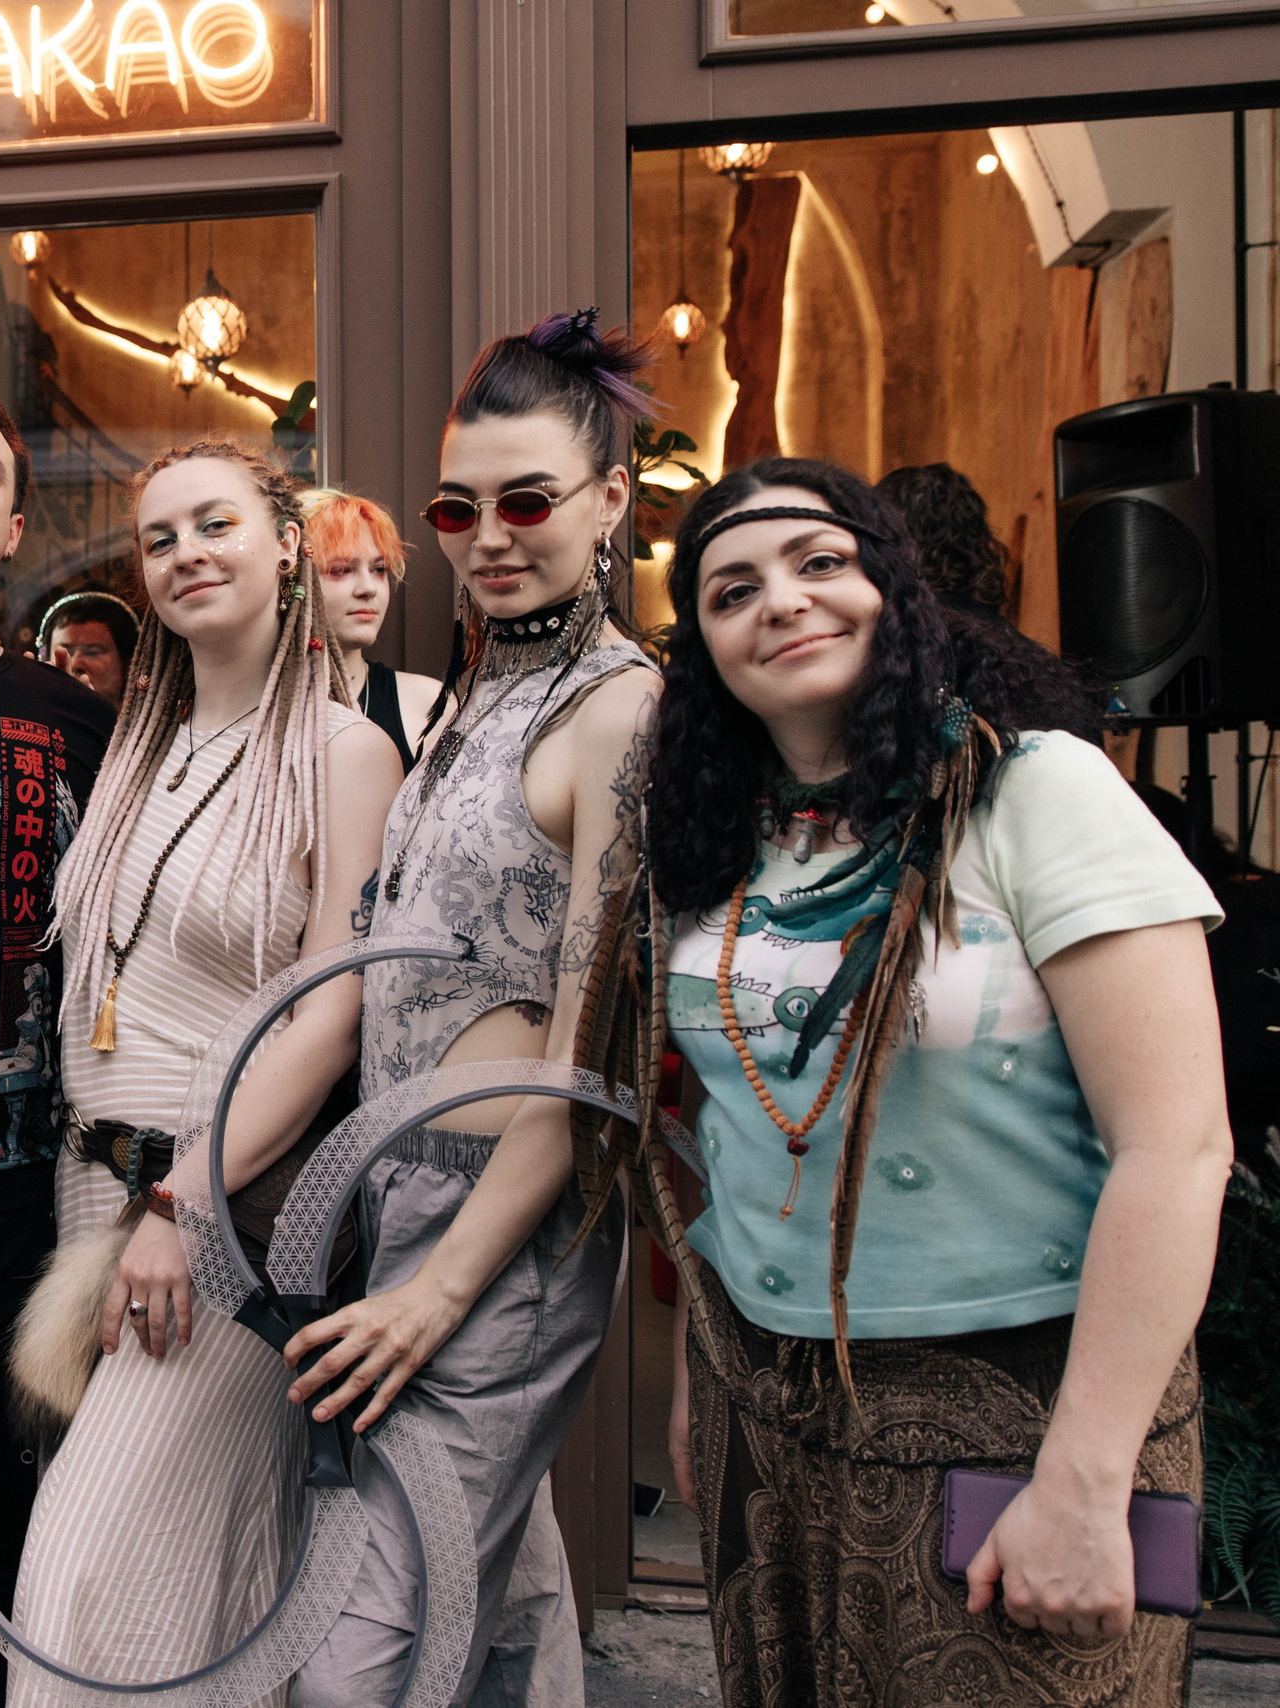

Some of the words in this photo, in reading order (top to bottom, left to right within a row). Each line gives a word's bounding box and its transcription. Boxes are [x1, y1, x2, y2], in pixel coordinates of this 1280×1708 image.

[12, 746, 46, 924] 魂の中の火
